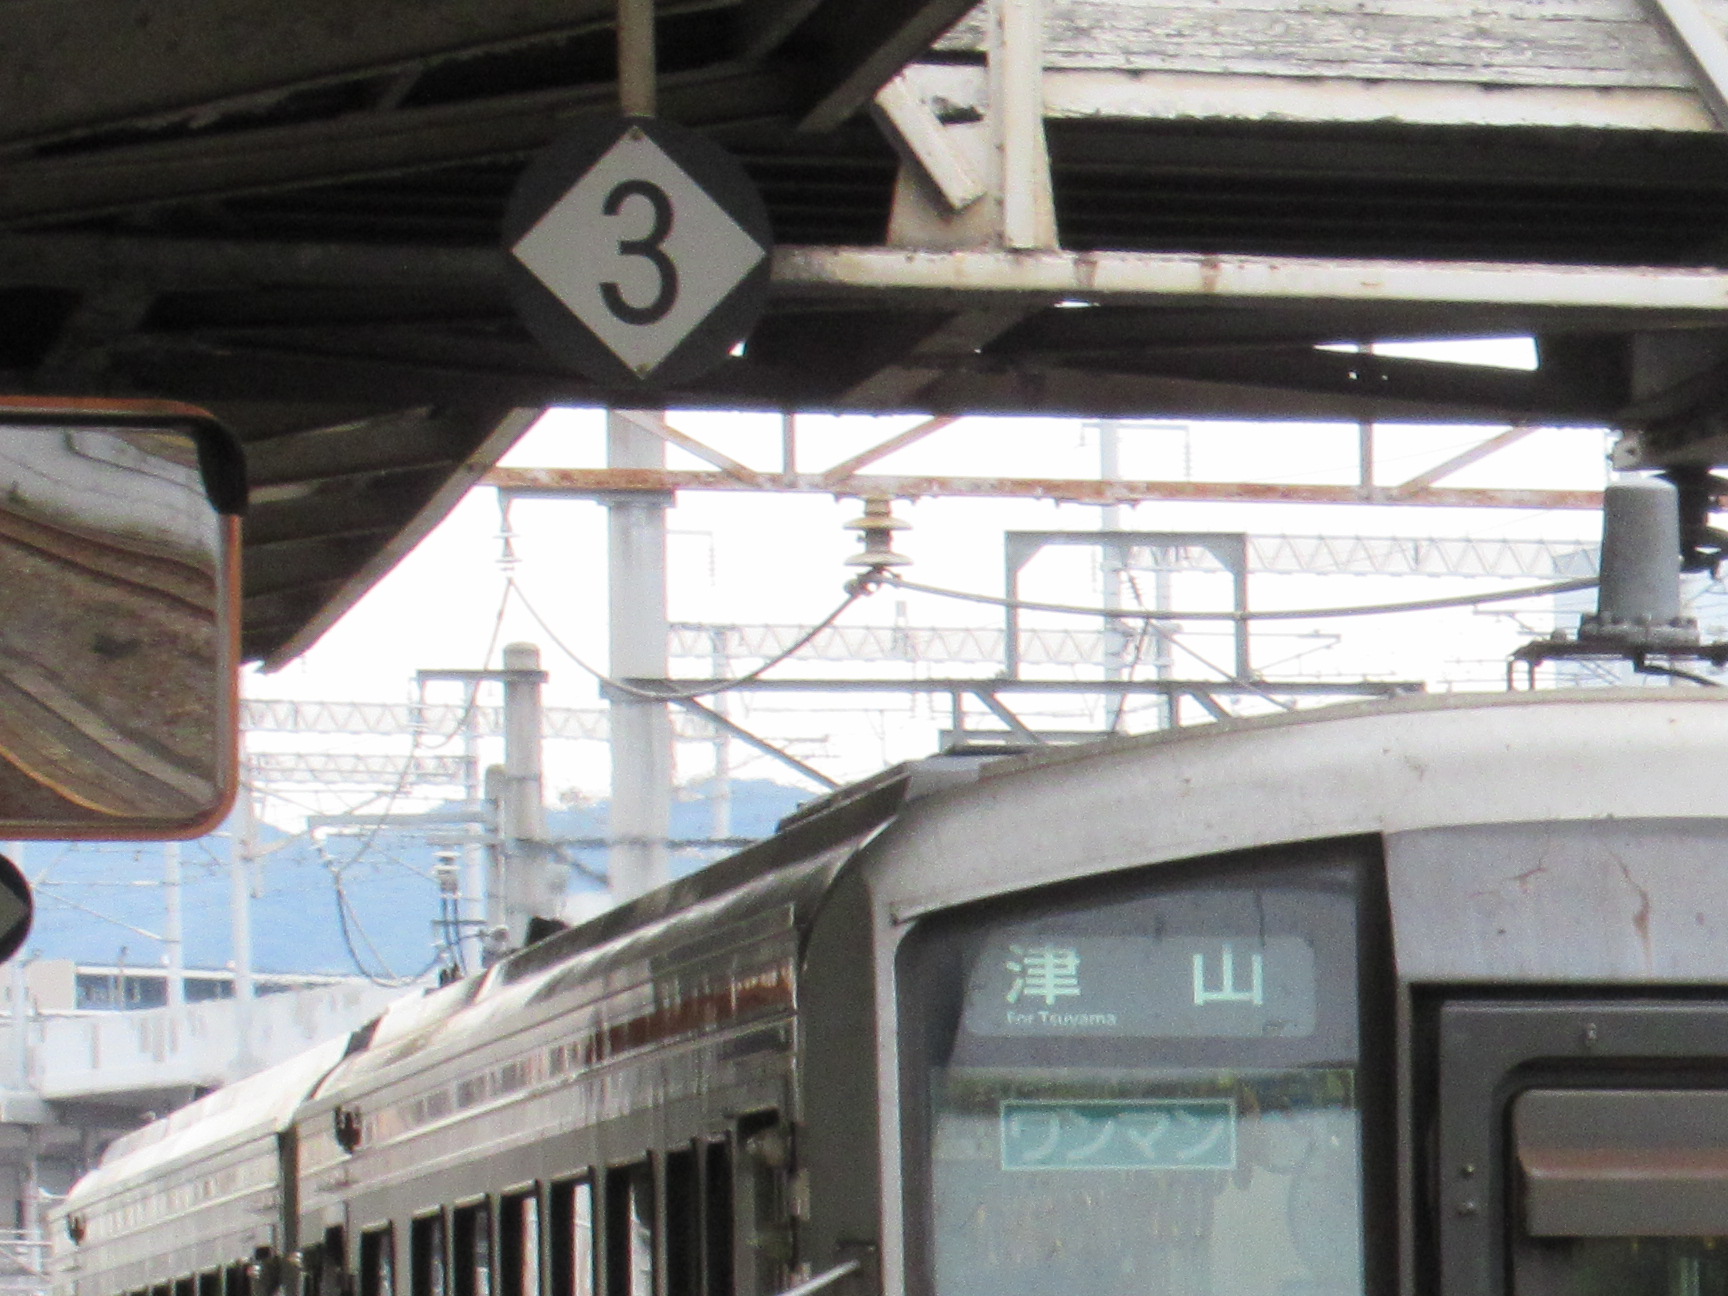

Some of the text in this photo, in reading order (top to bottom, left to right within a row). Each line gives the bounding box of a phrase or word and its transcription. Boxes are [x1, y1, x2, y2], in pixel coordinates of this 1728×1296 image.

[600, 180, 678, 326] 3
[1005, 943, 1263, 1006] 津山
[1011, 1109, 1225, 1160] ワンマン
